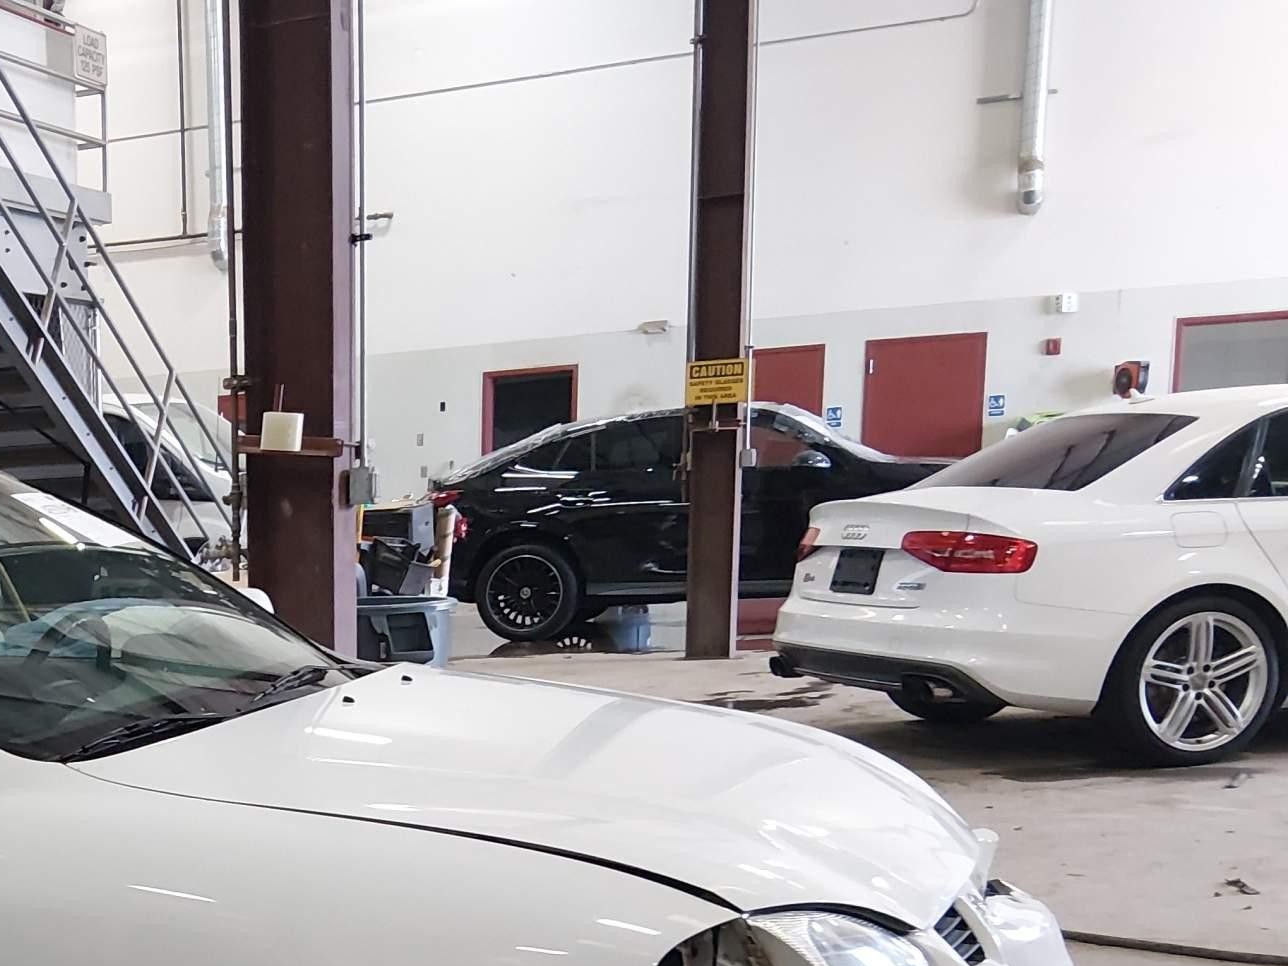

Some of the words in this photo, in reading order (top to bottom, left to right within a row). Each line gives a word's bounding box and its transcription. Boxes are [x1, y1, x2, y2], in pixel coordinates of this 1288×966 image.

[82, 34, 99, 50] LOAD
[77, 45, 105, 66] CAPACITY
[692, 364, 743, 377] CAUTION
